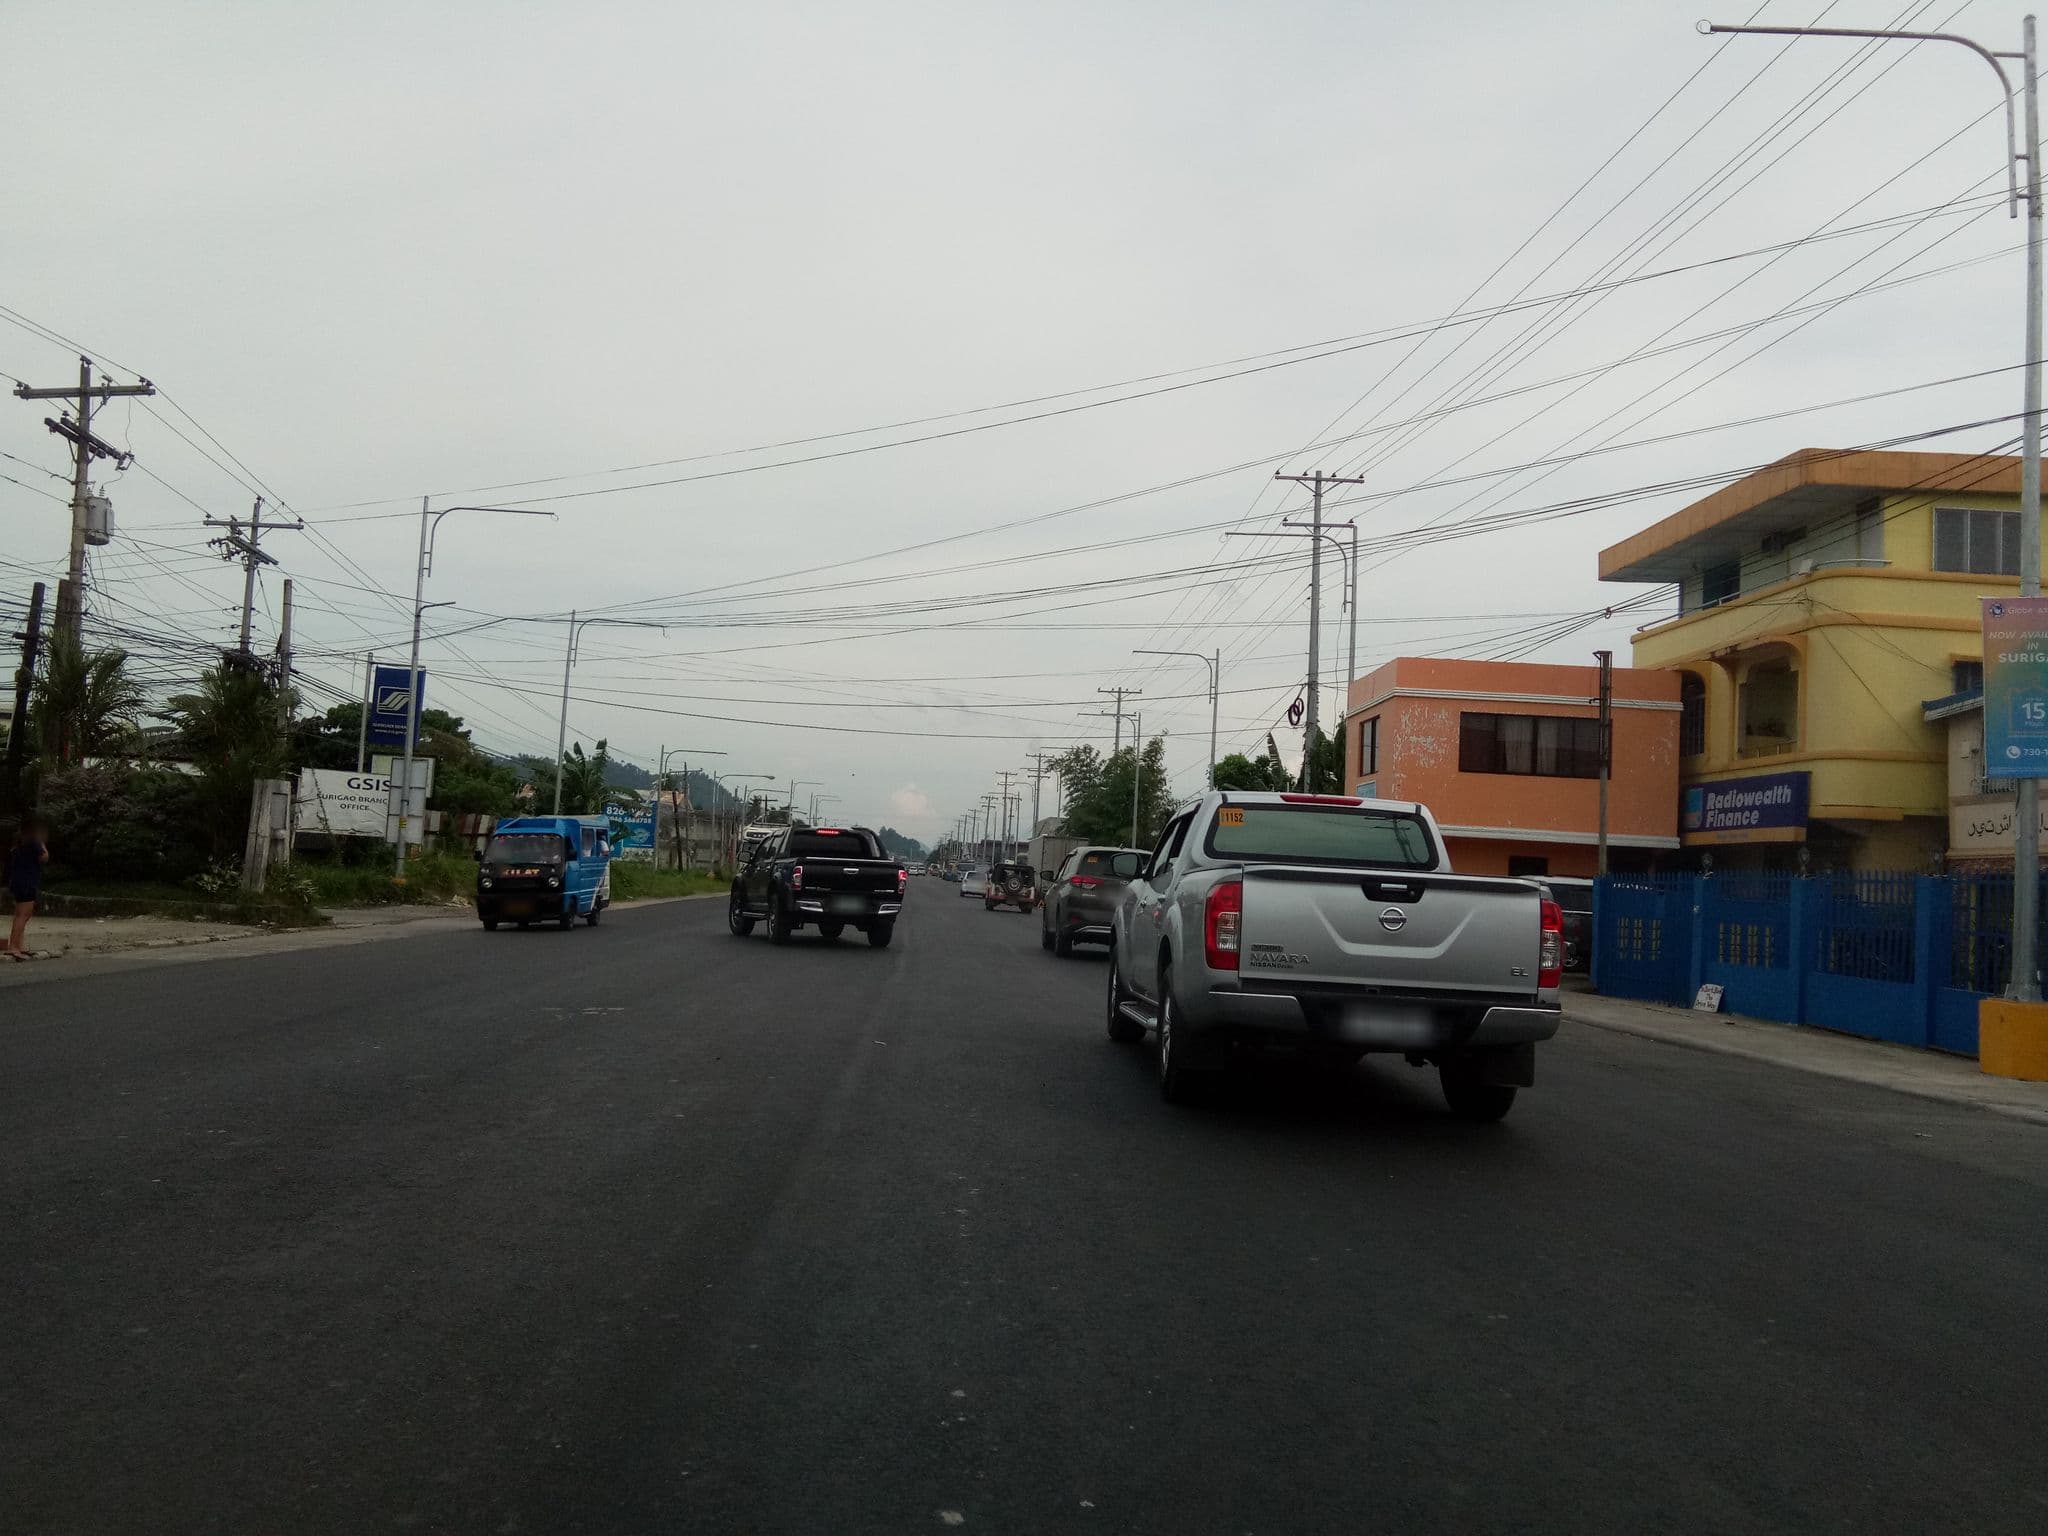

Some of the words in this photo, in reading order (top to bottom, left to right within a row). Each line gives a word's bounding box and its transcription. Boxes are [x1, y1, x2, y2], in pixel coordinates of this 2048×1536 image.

[1989, 631, 2016, 640] NOW
[2027, 641, 2039, 651] IN
[1998, 652, 2048, 664] SURIG
[2021, 702, 2046, 719] 15
[347, 777, 391, 791] GSIS
[1706, 783, 1792, 810] Radiowealth
[339, 803, 370, 811] OFFICE
[1225, 812, 1244, 823] 1152
[1705, 809, 1760, 828] Finance
[1250, 953, 1310, 964] NAVARA
